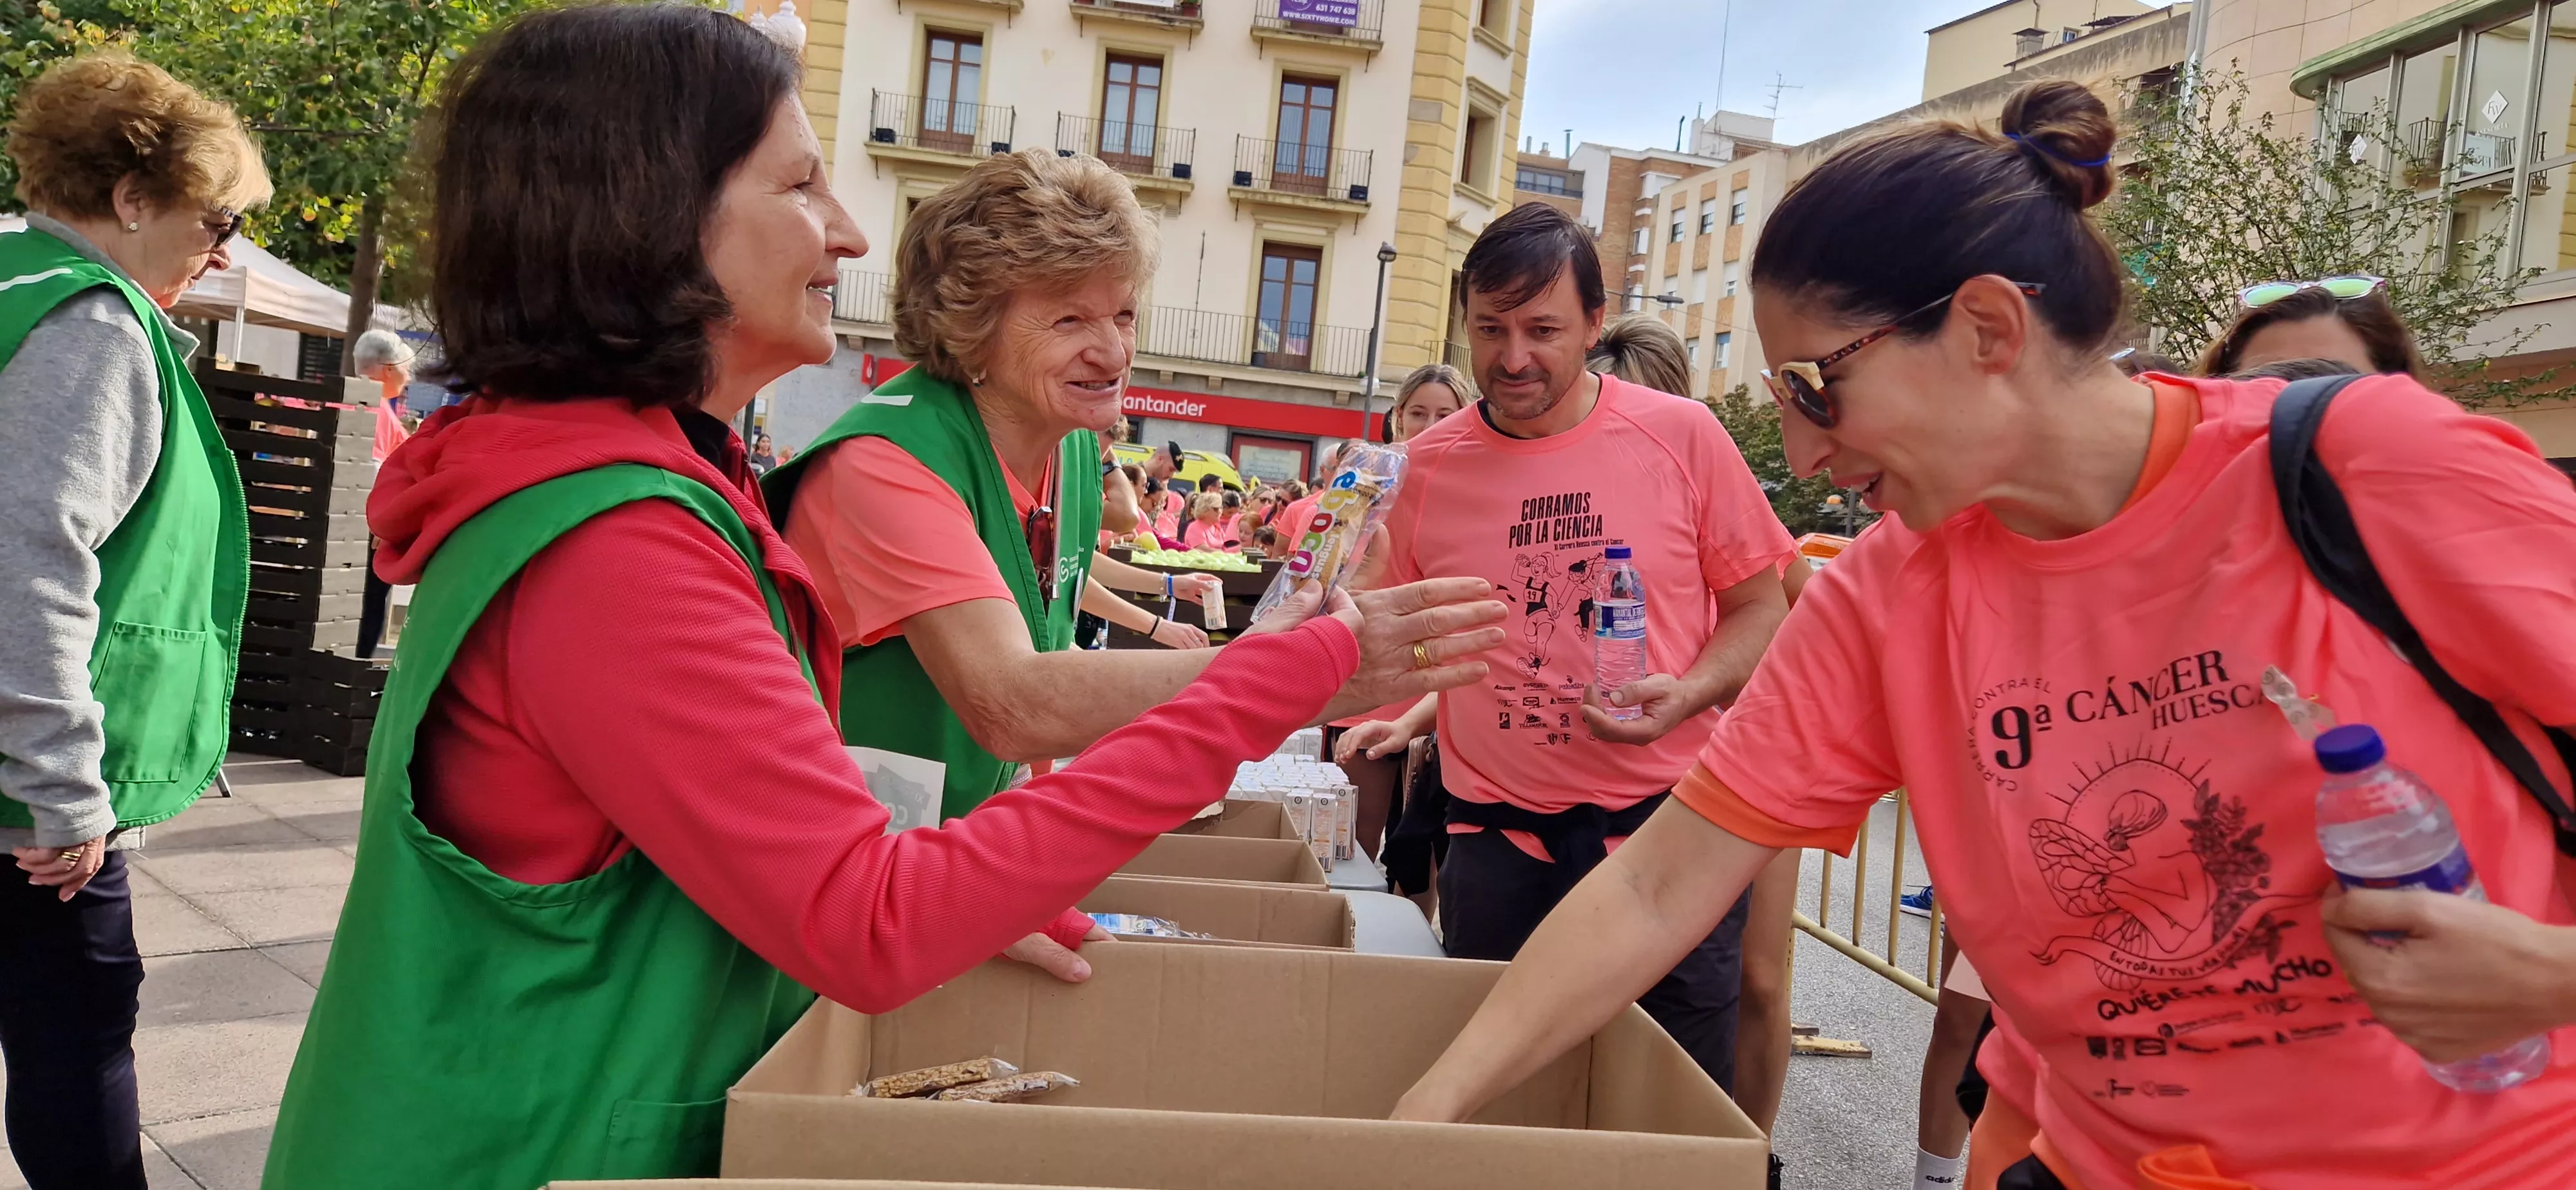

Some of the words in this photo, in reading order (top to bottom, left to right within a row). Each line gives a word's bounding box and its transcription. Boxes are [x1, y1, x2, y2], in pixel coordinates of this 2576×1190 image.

[1282, 11, 1355, 26] WWW.SIXTYHOME.COM
[1122, 394, 1206, 417] antander
[1521, 492, 1591, 522] CORRAMOS
[1509, 522, 1532, 549] POR
[1536, 520, 1548, 544] LA
[1553, 514, 1603, 542] CIENCIA
[1528, 590, 1537, 601] 19
[2065, 649, 2230, 723] CÁNCER
